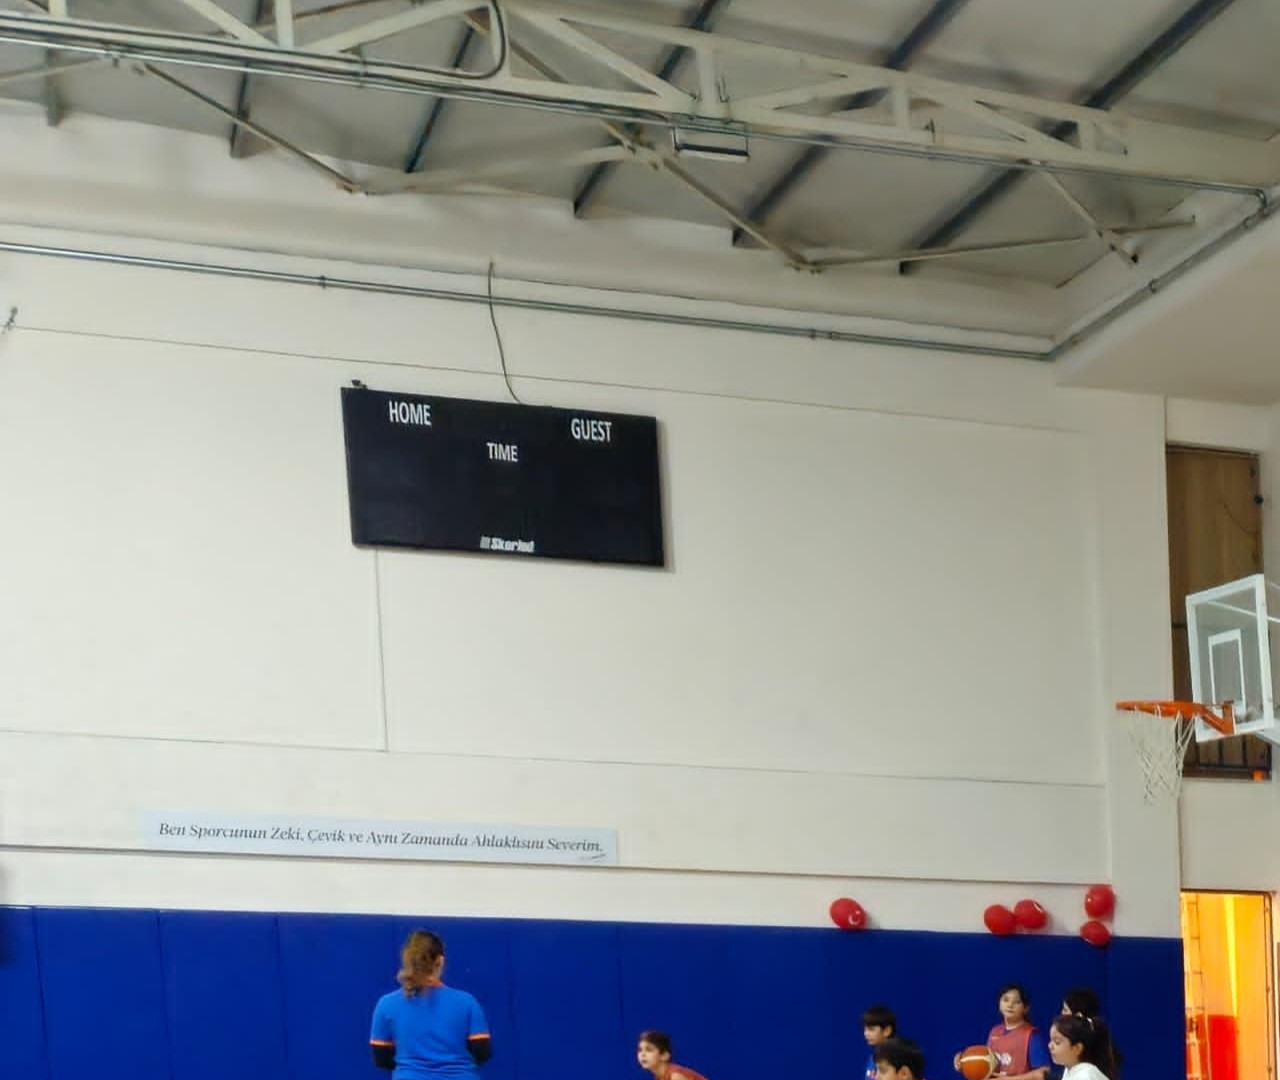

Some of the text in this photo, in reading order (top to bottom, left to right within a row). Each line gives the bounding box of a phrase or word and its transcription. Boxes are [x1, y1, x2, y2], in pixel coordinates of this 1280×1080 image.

[389, 400, 432, 426] HOME
[571, 418, 612, 443] GUEST
[486, 442, 518, 462] TIME
[159, 822, 186, 836] Ben
[190, 824, 267, 840] Sporcunun
[270, 827, 304, 842] Zeki,
[307, 828, 345, 844] Çevik
[349, 832, 364, 844] ve
[366, 831, 398, 846] Aynı
[400, 832, 469, 847] Zamanda
[547, 838, 604, 854] Severim.
